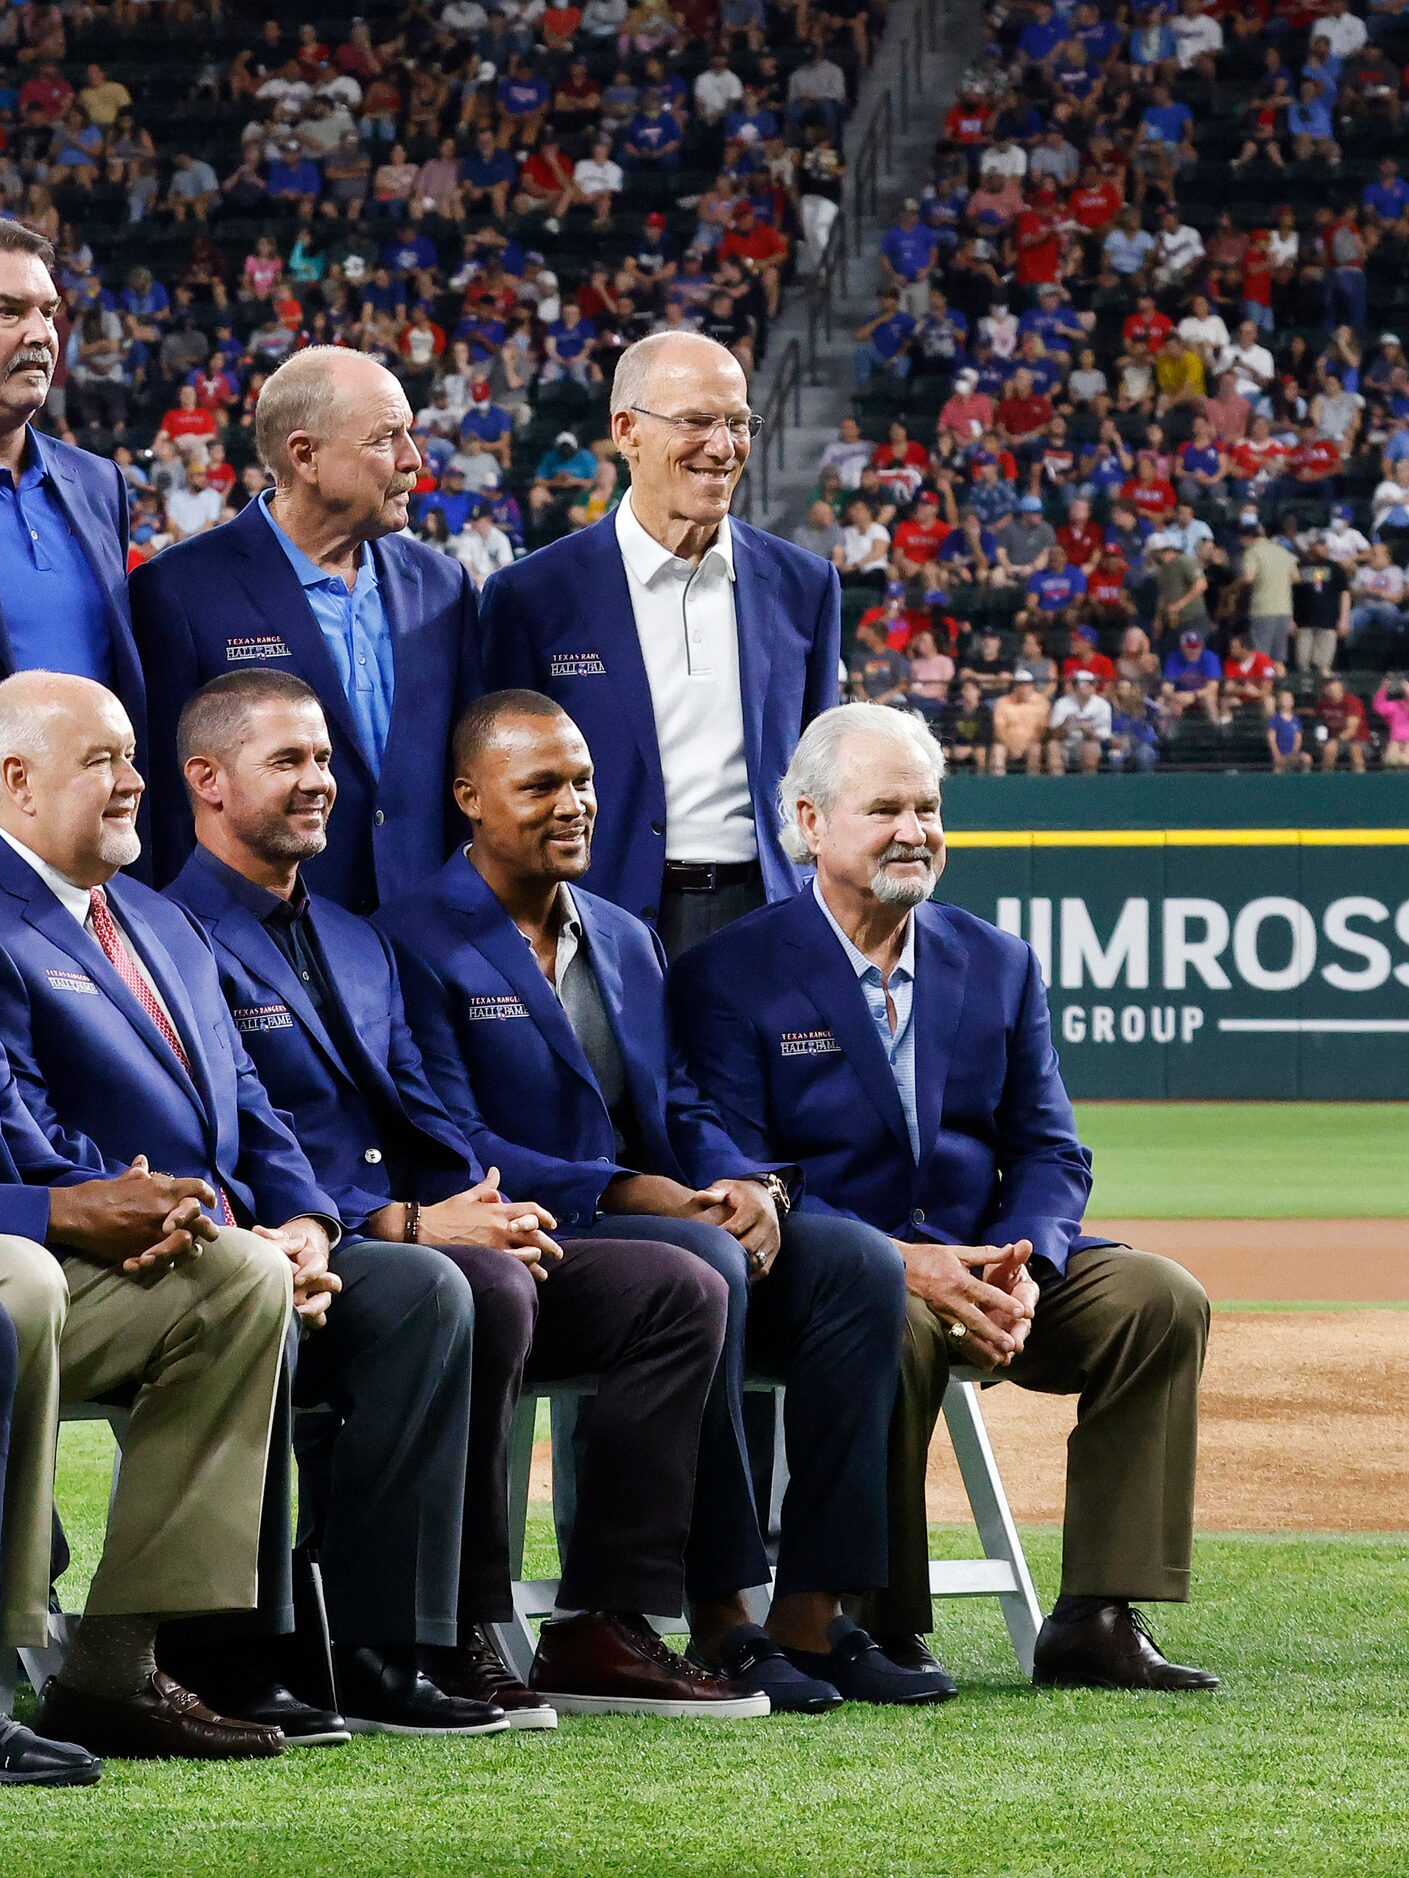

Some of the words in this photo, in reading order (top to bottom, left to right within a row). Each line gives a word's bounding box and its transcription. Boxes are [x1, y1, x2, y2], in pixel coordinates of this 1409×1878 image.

[227, 638, 255, 646] TEXAS
[226, 647, 255, 658] HALL
[553, 653, 579, 662] TEXAS
[551, 663, 577, 674] HALL
[997, 895, 1409, 992] IMROS
[45, 969, 66, 977] TEXAS
[50, 978, 72, 989] HALL
[471, 996, 496, 1005] TEXAS
[496, 996, 520, 1004] RANGE
[233, 1008, 259, 1017] TEXAS
[259, 1005, 287, 1014] RANGERS
[470, 1007, 496, 1018] HALL
[267, 1015, 293, 1026] FAME
[1062, 1004, 1204, 1043] GROUP
[781, 1042, 808, 1053] HALL
